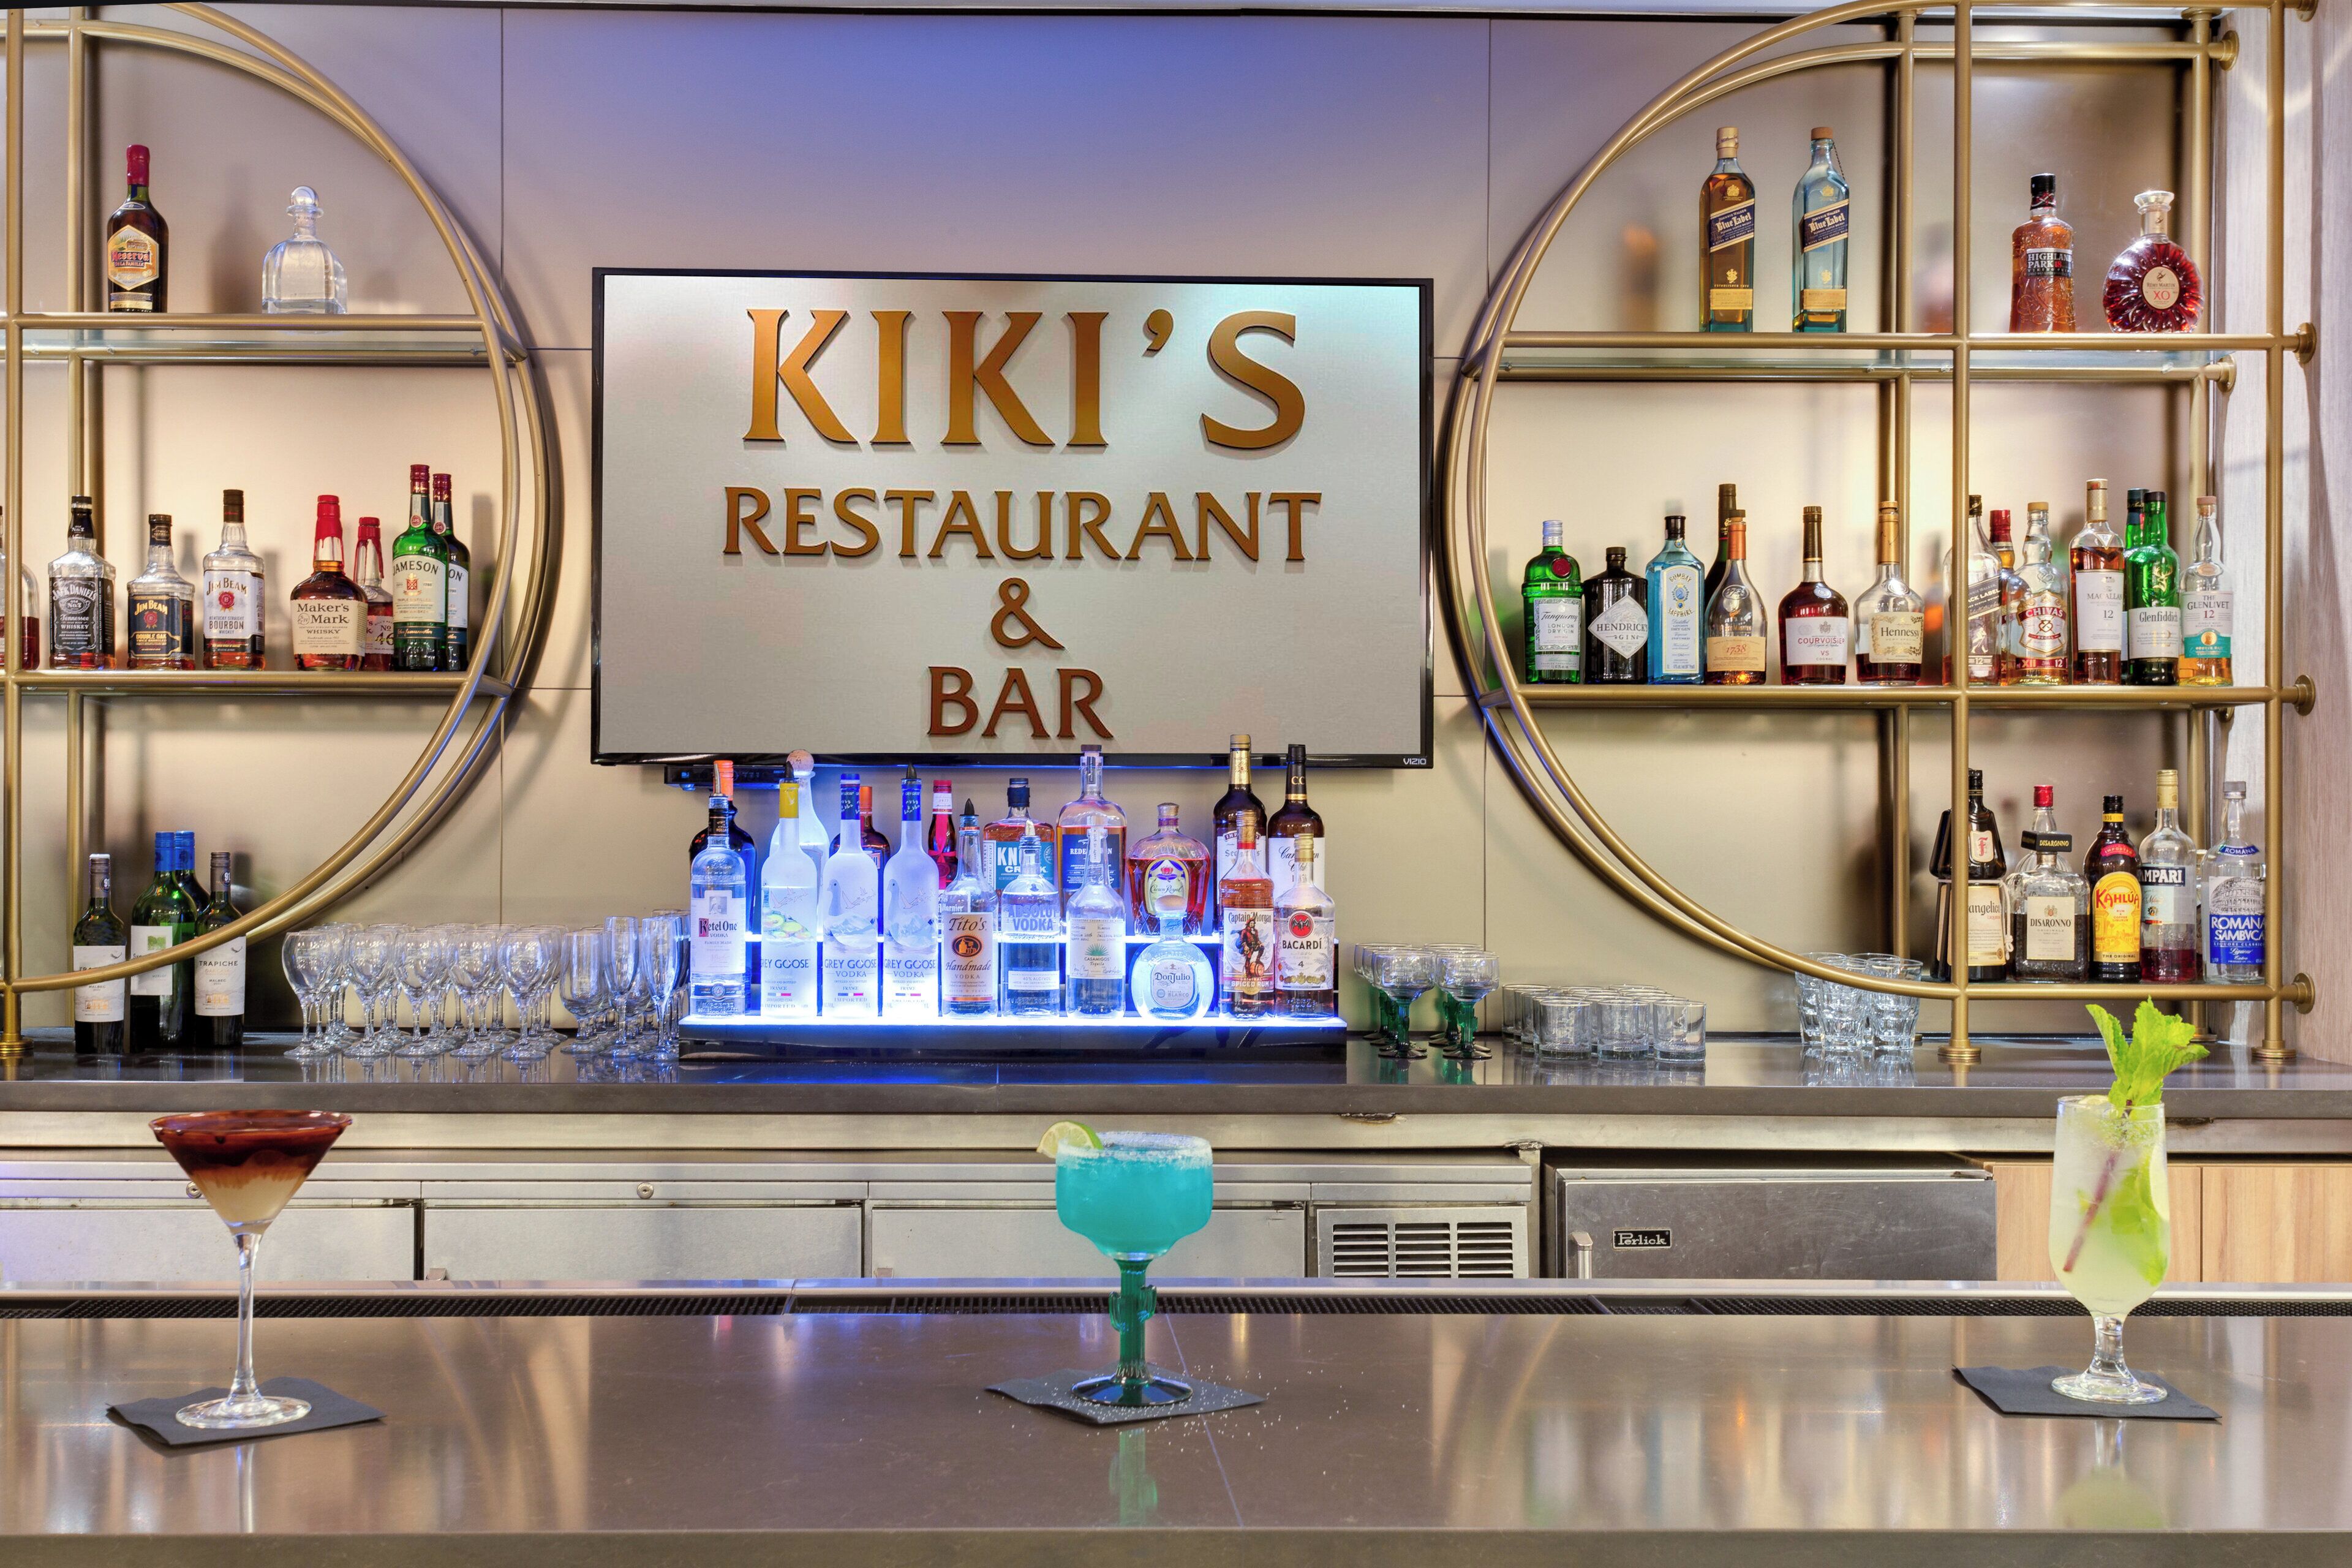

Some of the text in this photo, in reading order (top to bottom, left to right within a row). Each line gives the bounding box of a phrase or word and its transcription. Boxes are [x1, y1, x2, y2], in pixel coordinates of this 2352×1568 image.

[1716, 212, 1752, 232] Blue Label
[1808, 213, 1845, 232] Blue Label
[111, 251, 151, 262] Reserva
[2028, 252, 2071, 262] HIGHLAND
[2028, 260, 2054, 269] PARK
[2154, 290, 2171, 300] XO
[743, 307, 1306, 450] KIKI'S
[723, 486, 1322, 561] RESTAURANT
[393, 560, 439, 576] JAMESON
[1668, 573, 1692, 582] BOMBAY
[223, 578, 247, 594] BEAM
[52, 586, 69, 601] JACK
[1980, 588, 2001, 599] LABEL
[134, 600, 168, 616] JIM BEAM
[297, 603, 350, 612] Maker's
[2187, 601, 2230, 610] GLENLIVET
[990, 577, 1065, 650] &
[1541, 612, 1579, 622] Tanqueray
[1668, 608, 1694, 617] SAPPHIRE
[2026, 608, 2063, 617] CHIVAS
[2103, 610, 2114, 619] 12
[2204, 609, 2215, 619] 12
[310, 614, 349, 624] Mark
[209, 620, 244, 630] BOURBON
[375, 631, 394, 646] 46
[1726, 644, 1747, 655] 1738
[2054, 659, 2063, 668] 12
[927, 666, 1114, 738] BAR
[1166, 885, 1184, 894] Royal
[2095, 889, 2140, 910] KAHLÚA
[1008, 904, 1057, 918] ABSOLUT
[1229, 911, 1272, 924] Captain Morgan
[2030, 919, 2071, 927] DISARONNO
[699, 920, 737, 934] Ketel One
[949, 916, 987, 931] Tito's
[1012, 918, 1054, 931] VODKA
[1282, 938, 1322, 949] BACARDÍ
[774, 959, 809, 968] GOOSE
[824, 959, 877, 968] GREY GOOSE
[884, 959, 936, 969] GREY GOOSE
[946, 960, 991, 971] Handmade
[1618, 1233, 1667, 1245] Perlick
